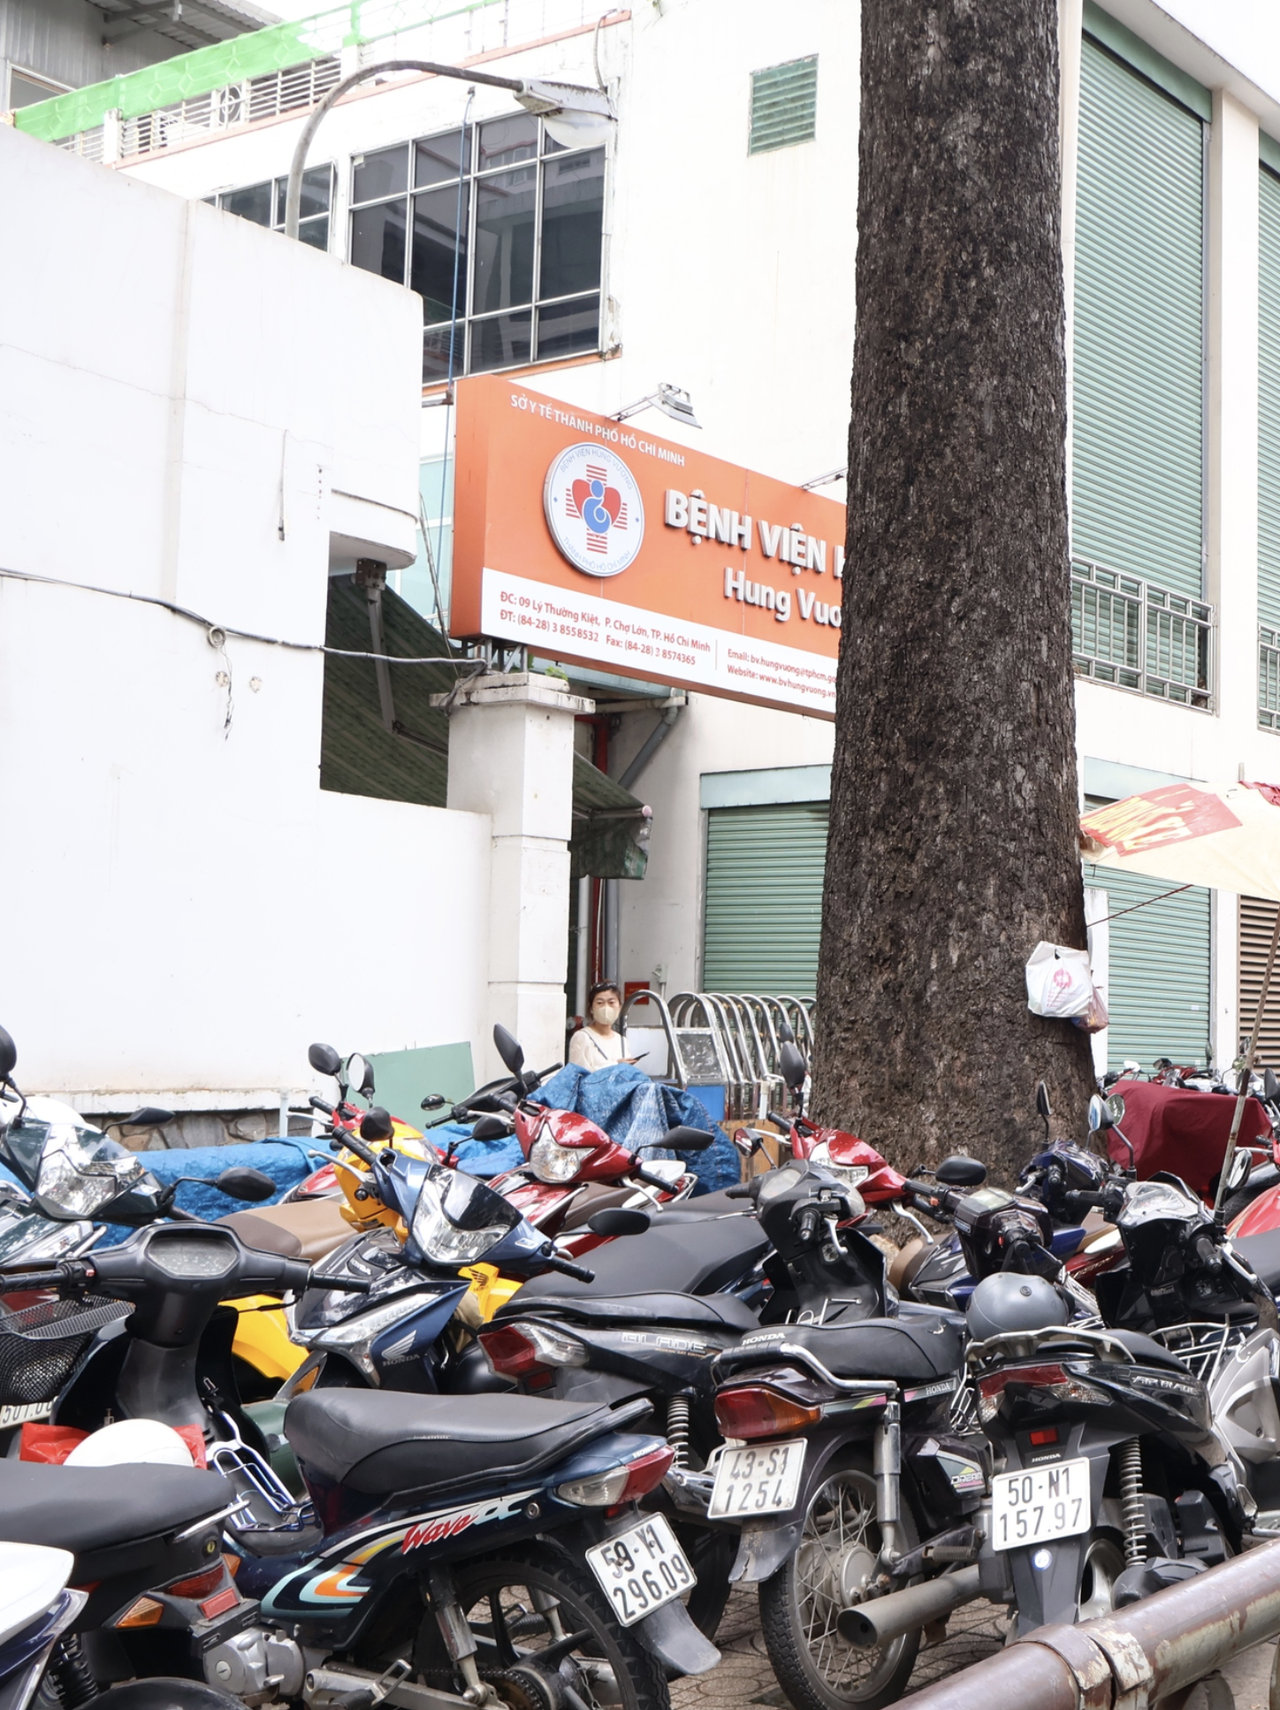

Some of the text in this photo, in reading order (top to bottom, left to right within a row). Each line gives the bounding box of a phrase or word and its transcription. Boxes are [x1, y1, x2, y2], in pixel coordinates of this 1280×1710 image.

[511, 393, 686, 467] SỞ Y TẾ THÀNH PHỐ HỒ CHÍ MINH
[665, 489, 752, 552] BỆNH
[757, 522, 827, 575] VIỆN
[724, 566, 791, 622] Hung
[500, 591, 710, 652] ĐC: 09 Lý Thường Kiệt, P. Chợ Lớn, TP. Hồ Chí Minh
[500, 609, 696, 666] ĐT: (84-28) 3 8558532 Fax: (84-28) 3 8574365
[727, 664, 758, 679] Website:
[728, 648, 750, 662] Email:
[621, 1332, 708, 1355] BLADE
[742, 1332, 786, 1346] HONDA
[382, 1354, 420, 1367] HONDA
[926, 1382, 951, 1395] HONDA
[632, 1442, 660, 1459] HONDA
[730, 1446, 789, 1480] 43-S1
[1032, 1453, 1062, 1463] HONDA
[725, 1479, 783, 1513] 1254
[1008, 1467, 1069, 1507] 50-N1
[401, 1514, 479, 1556] Wave
[999, 1497, 1082, 1542] 157.97
[613, 1553, 690, 1620] 296.09
